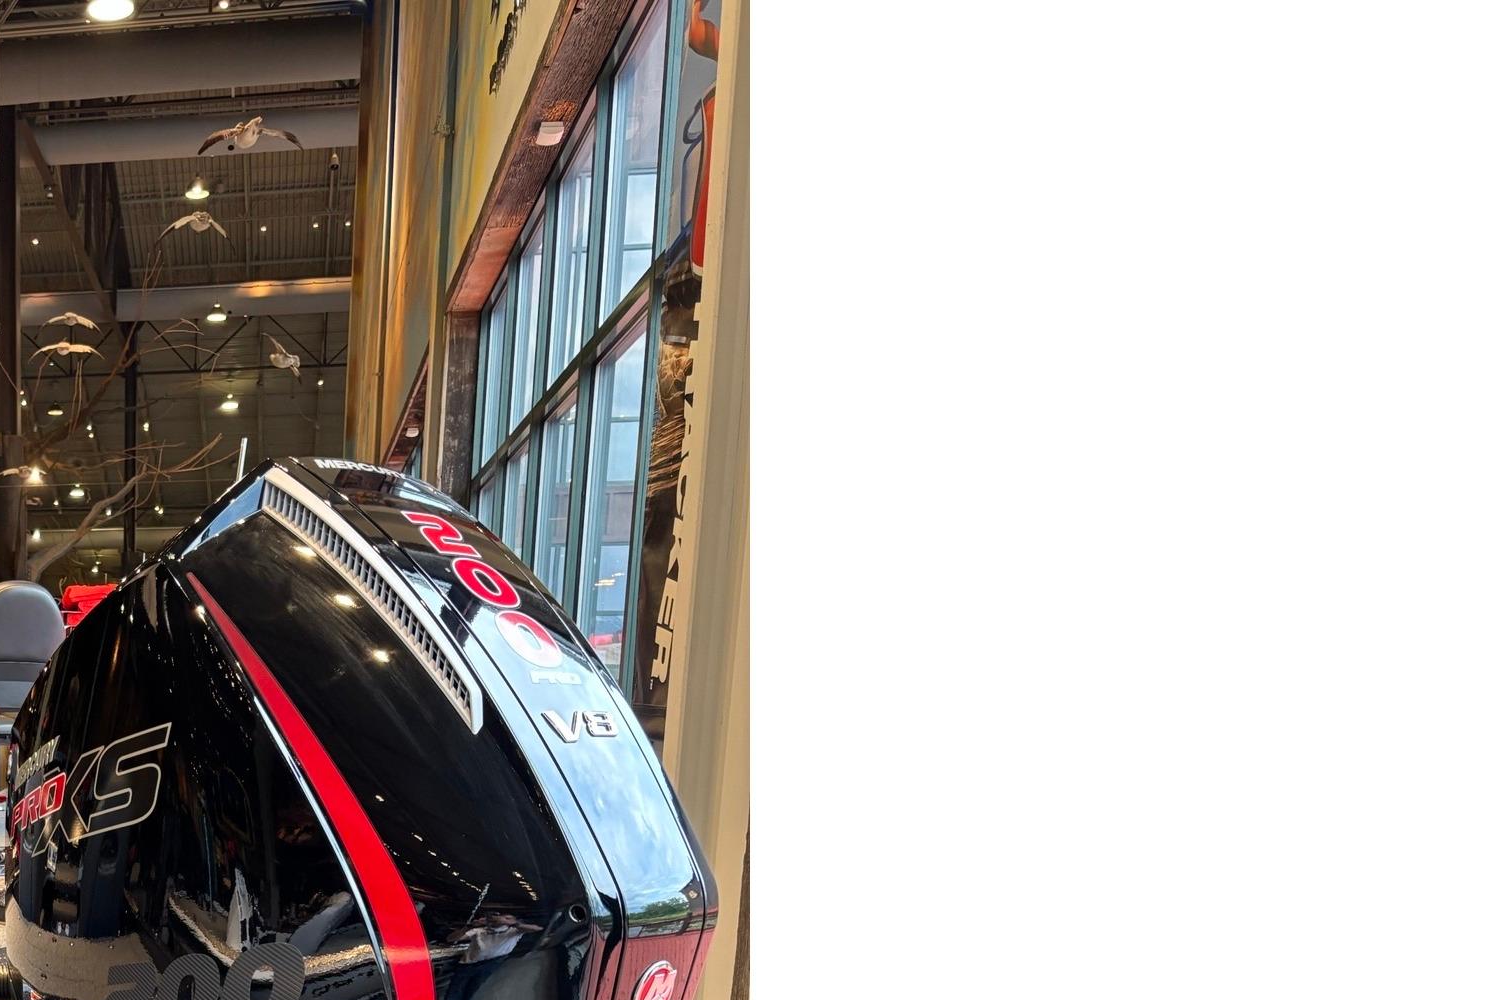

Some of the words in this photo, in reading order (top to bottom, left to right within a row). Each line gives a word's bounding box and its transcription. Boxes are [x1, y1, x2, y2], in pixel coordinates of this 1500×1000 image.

[314, 459, 406, 479] MERCURY
[400, 510, 563, 669] 200
[540, 709, 618, 743] V8
[9, 771, 67, 841] PRO
